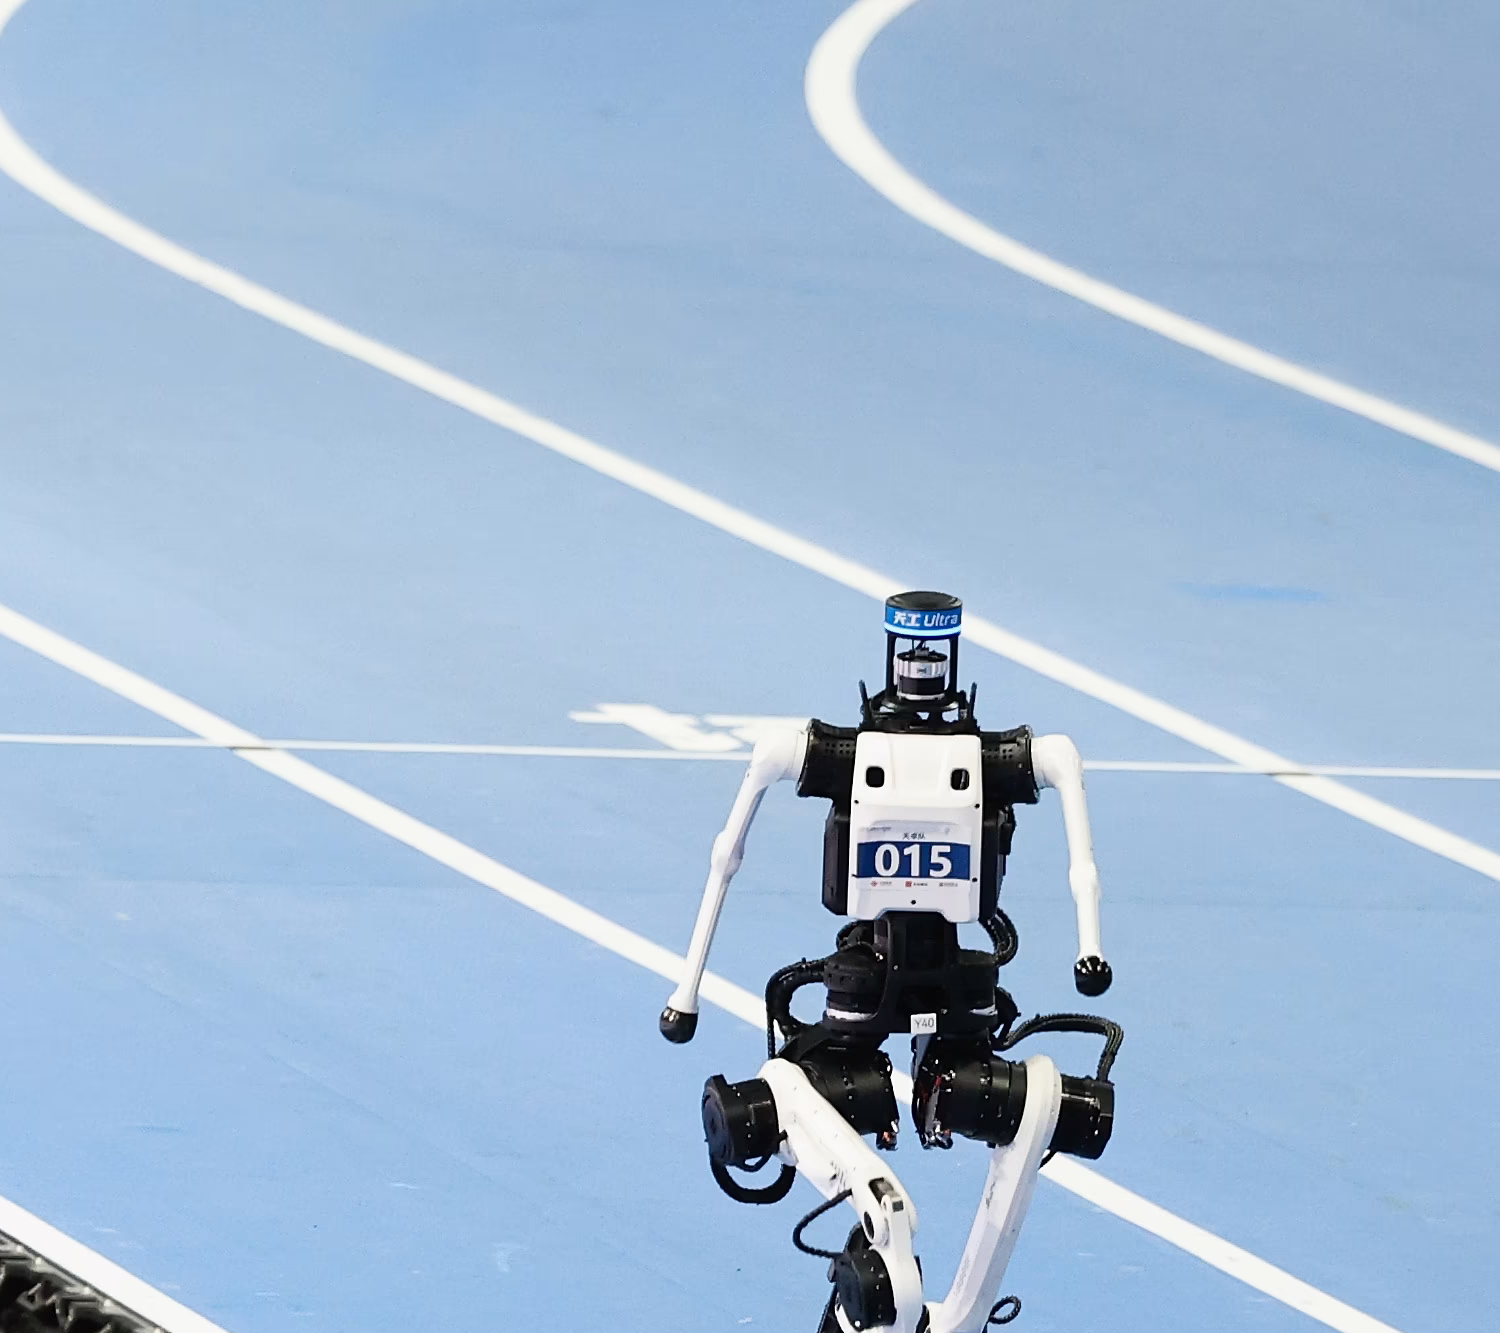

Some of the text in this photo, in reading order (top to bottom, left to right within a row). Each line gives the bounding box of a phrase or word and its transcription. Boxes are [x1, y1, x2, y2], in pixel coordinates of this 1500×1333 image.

[893, 611, 958, 627] 天工 Ultra
[875, 843, 953, 878] 015
